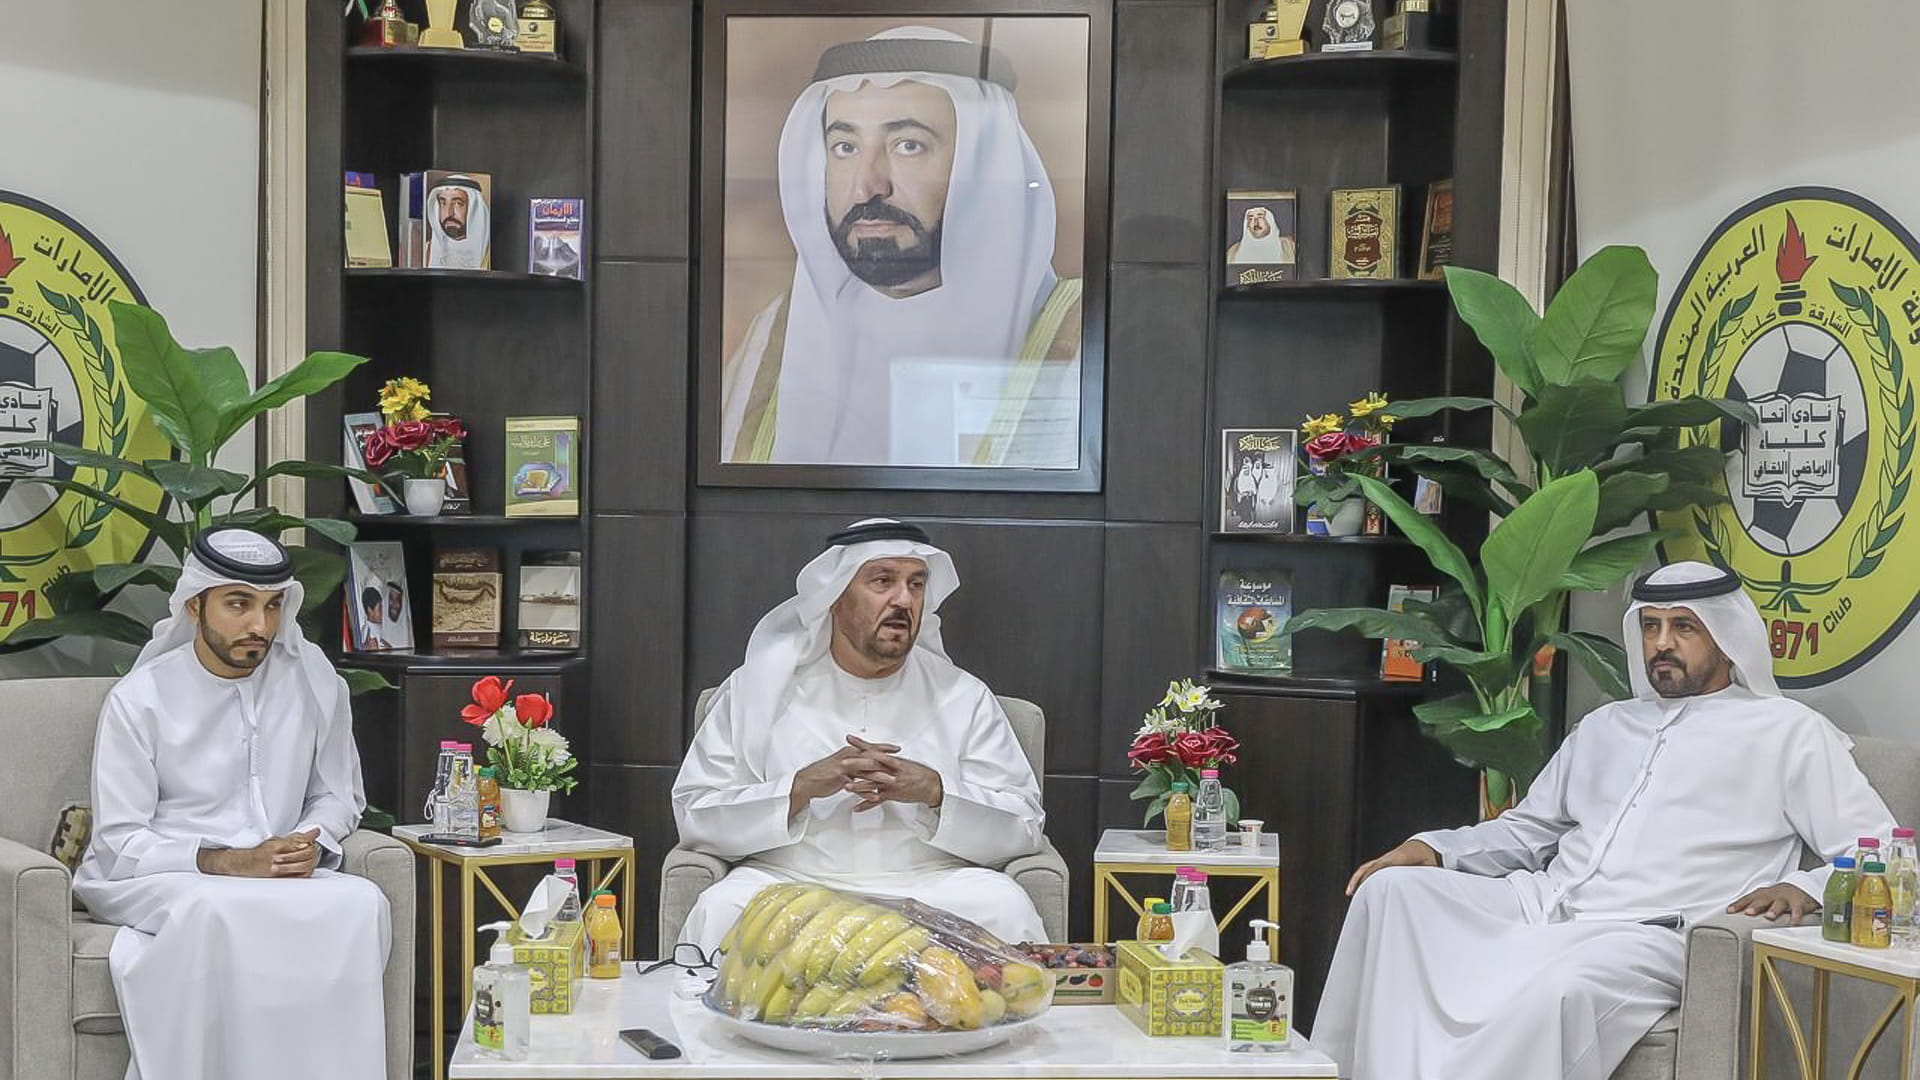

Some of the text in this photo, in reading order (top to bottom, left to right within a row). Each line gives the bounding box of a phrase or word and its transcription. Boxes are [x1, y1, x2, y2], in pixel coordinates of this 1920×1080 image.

[33, 235, 116, 304] الإمارات
[1665, 223, 1908, 400] الإمارات العربية المتحدة
[1741, 303, 1852, 345] الشارقة كلباء
[1761, 403, 1831, 429] نادي اتحا
[1760, 430, 1826, 452] كلباء
[1823, 597, 1852, 633] Club
[1763, 618, 1819, 660] 971
